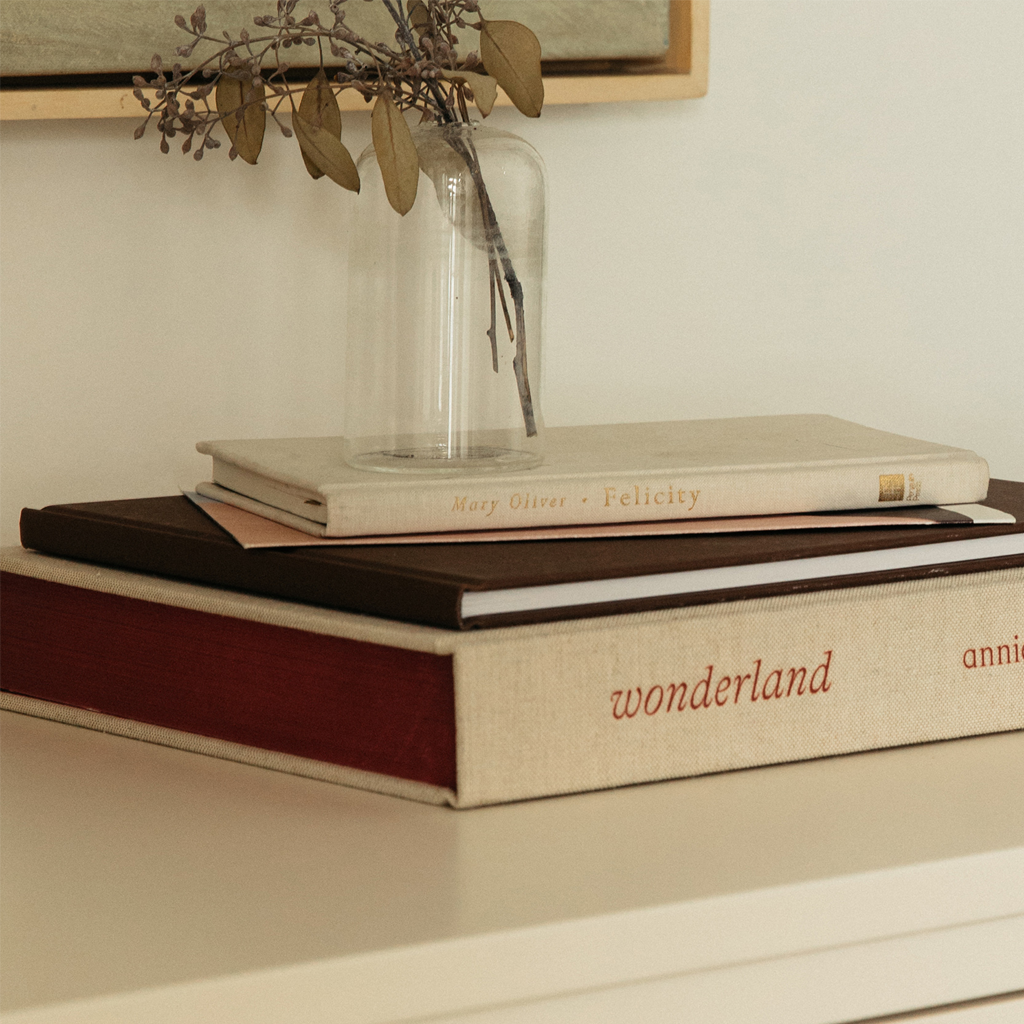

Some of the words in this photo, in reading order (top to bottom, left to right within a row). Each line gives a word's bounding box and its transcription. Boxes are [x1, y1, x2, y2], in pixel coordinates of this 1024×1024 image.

[452, 495, 499, 517] Mary
[508, 493, 567, 510] Oliver
[603, 485, 702, 511] Felicity
[610, 650, 833, 720] wonderland
